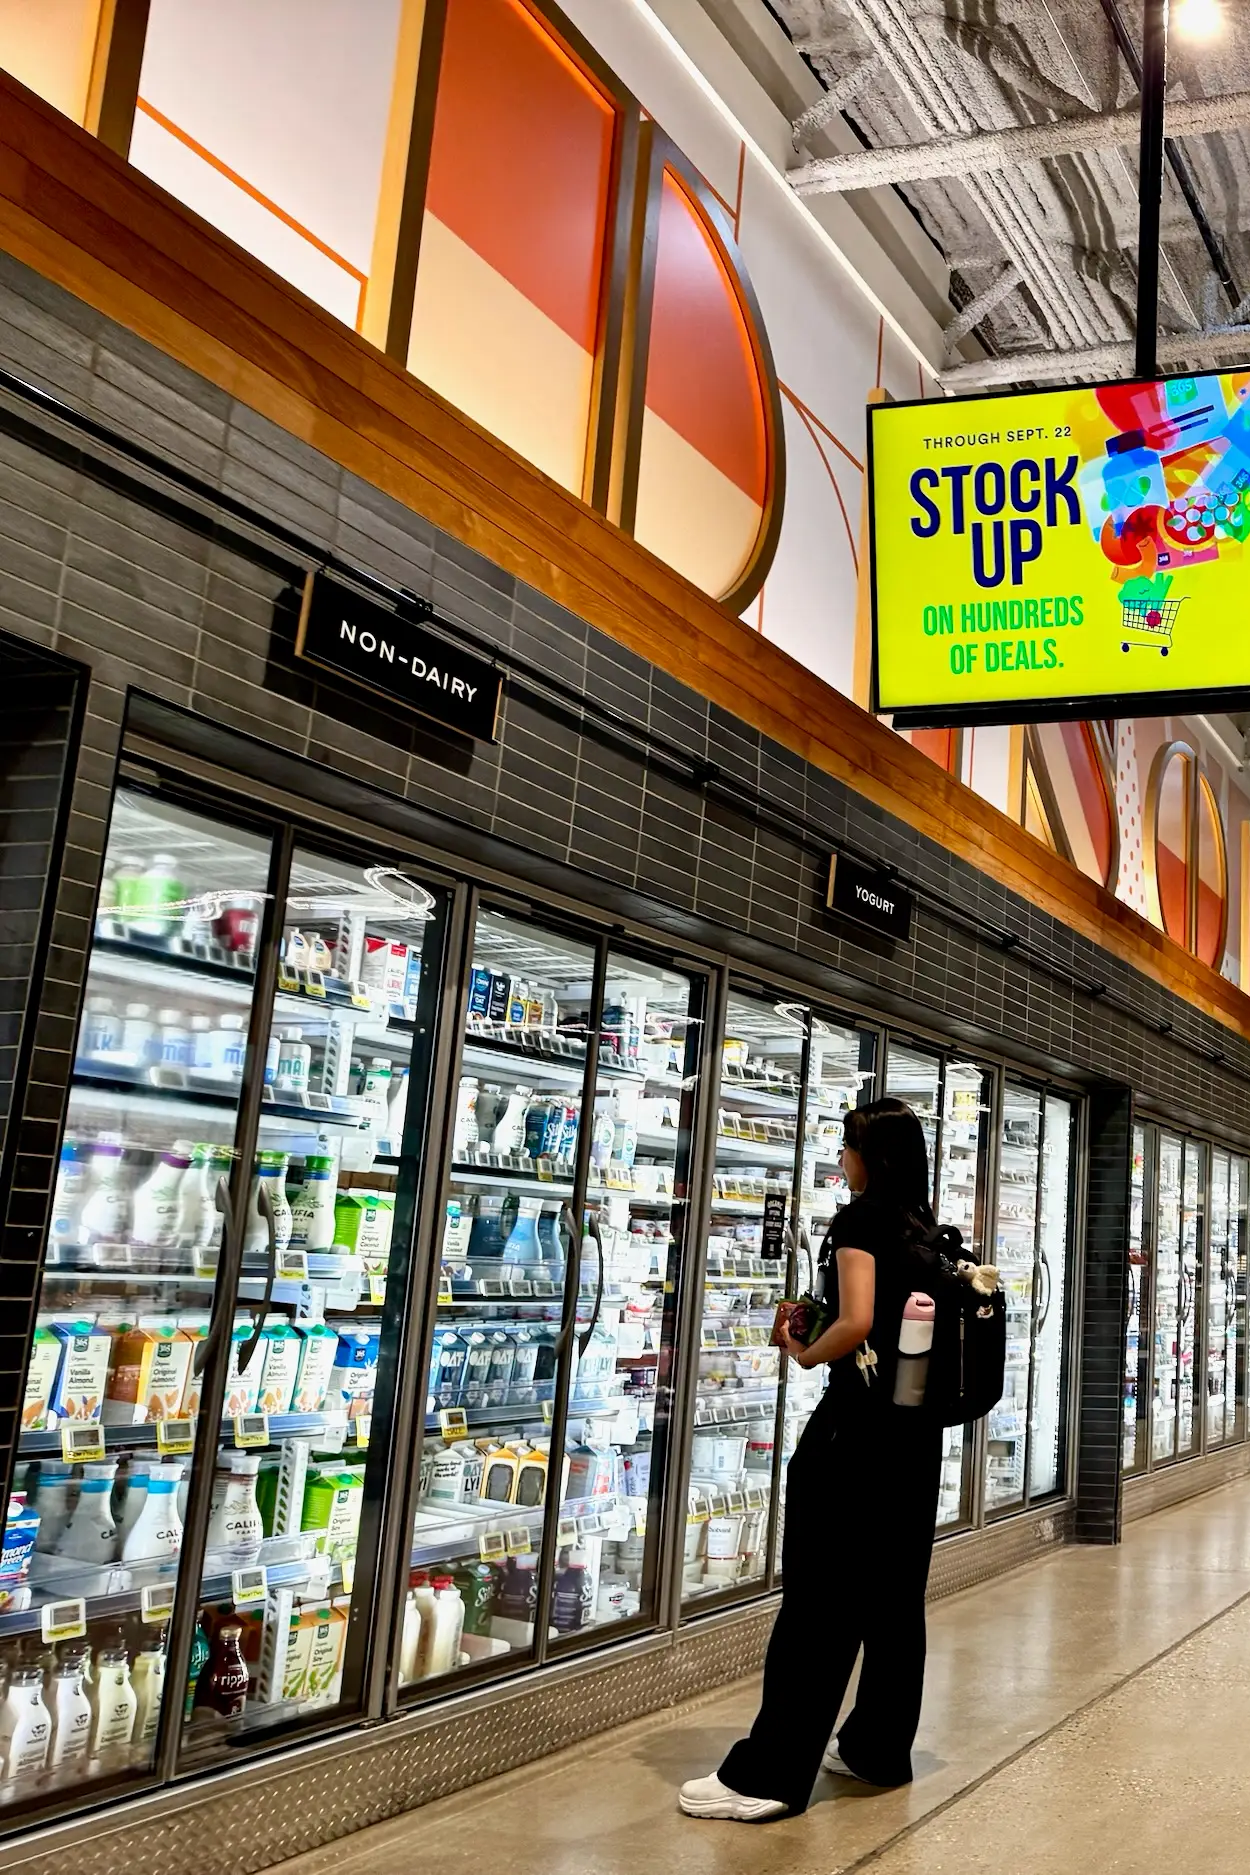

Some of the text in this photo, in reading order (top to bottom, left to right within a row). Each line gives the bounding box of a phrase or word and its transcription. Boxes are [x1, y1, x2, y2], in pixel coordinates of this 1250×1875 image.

[923, 426, 1072, 450] THROUGH SEPT. 22
[909, 455, 1081, 538] STOCK
[972, 519, 1042, 588] UP
[923, 596, 1084, 636] ON HUNDREDS
[340, 620, 478, 702] NON-DAIRY
[950, 639, 1064, 674] OF DEALS.
[856, 884, 894, 914] YOGURT
[68, 1376, 94, 1384] Almond
